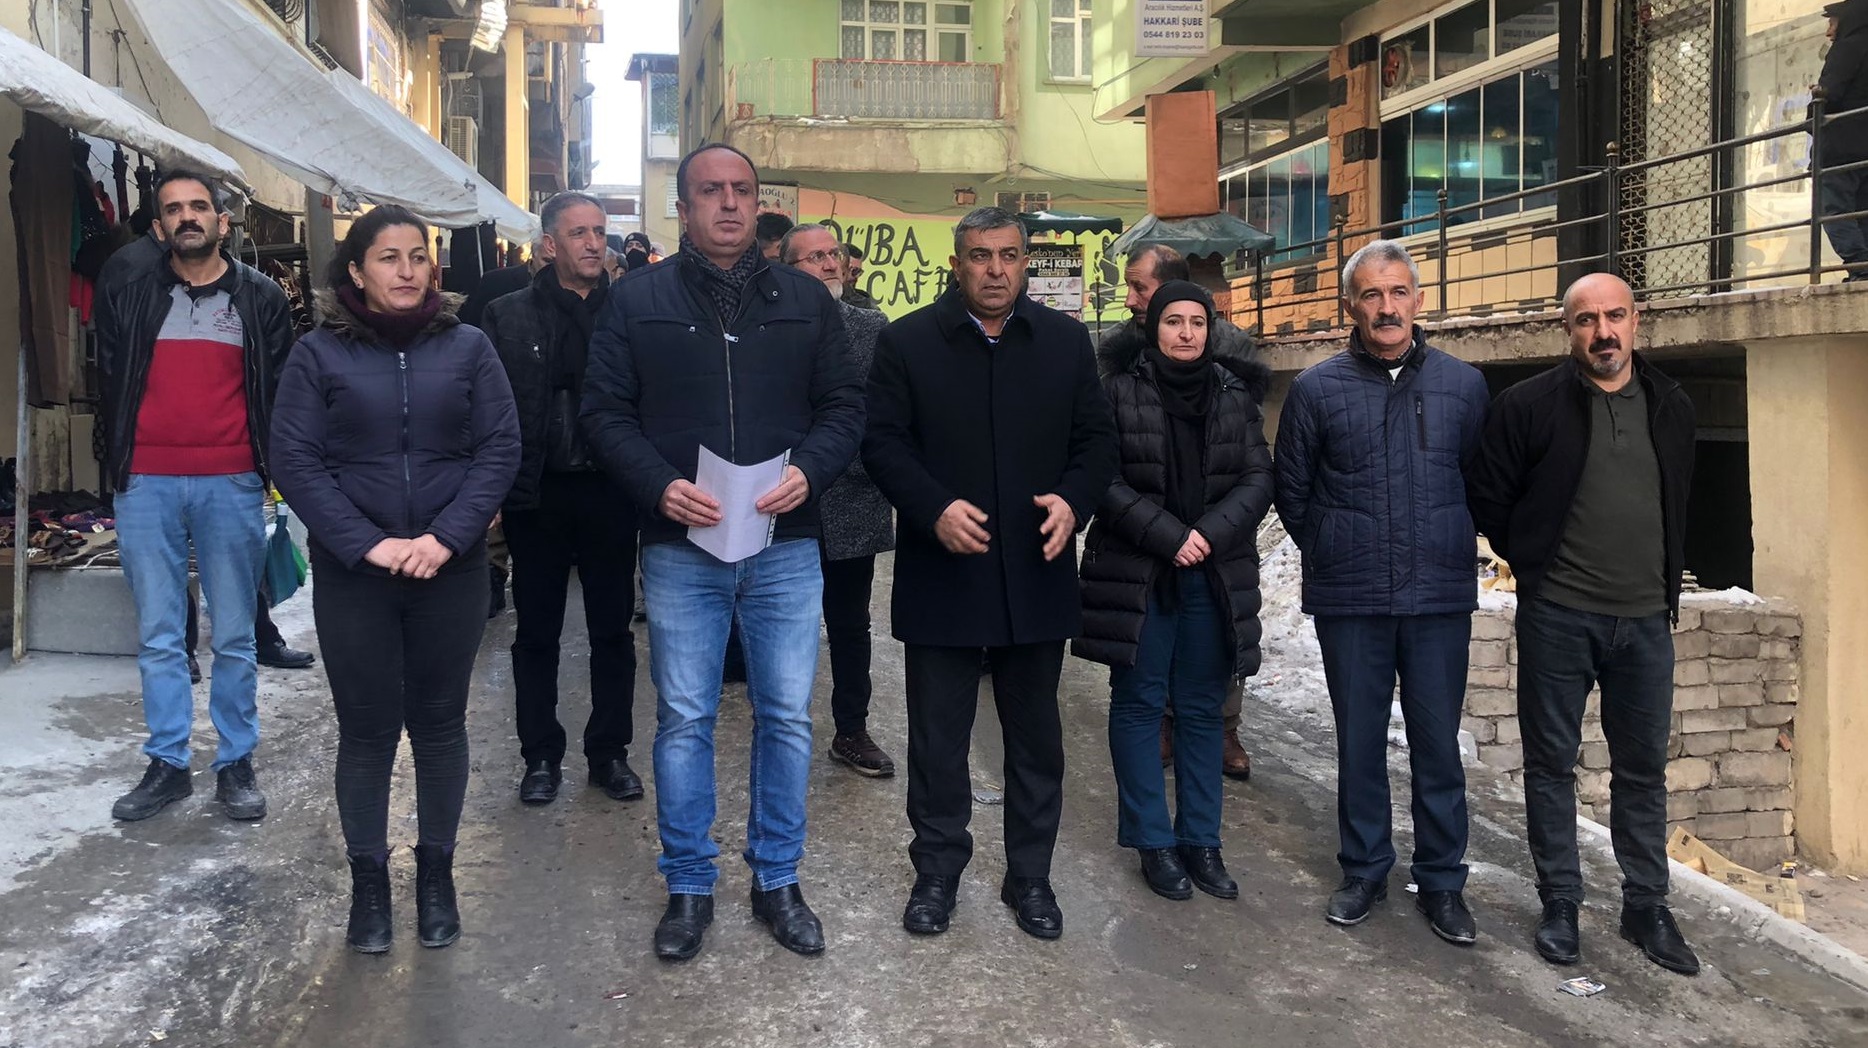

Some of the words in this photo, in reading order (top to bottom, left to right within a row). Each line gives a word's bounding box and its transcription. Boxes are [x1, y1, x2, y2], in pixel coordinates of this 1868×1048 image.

[1143, 16, 1180, 26] HAKKARİ
[1182, 17, 1203, 27] ŞUBE
[1143, 31, 1163, 39] 0544
[1165, 31, 1180, 39] 819
[1182, 31, 1192, 39] 23
[1194, 31, 1204, 39] 03
